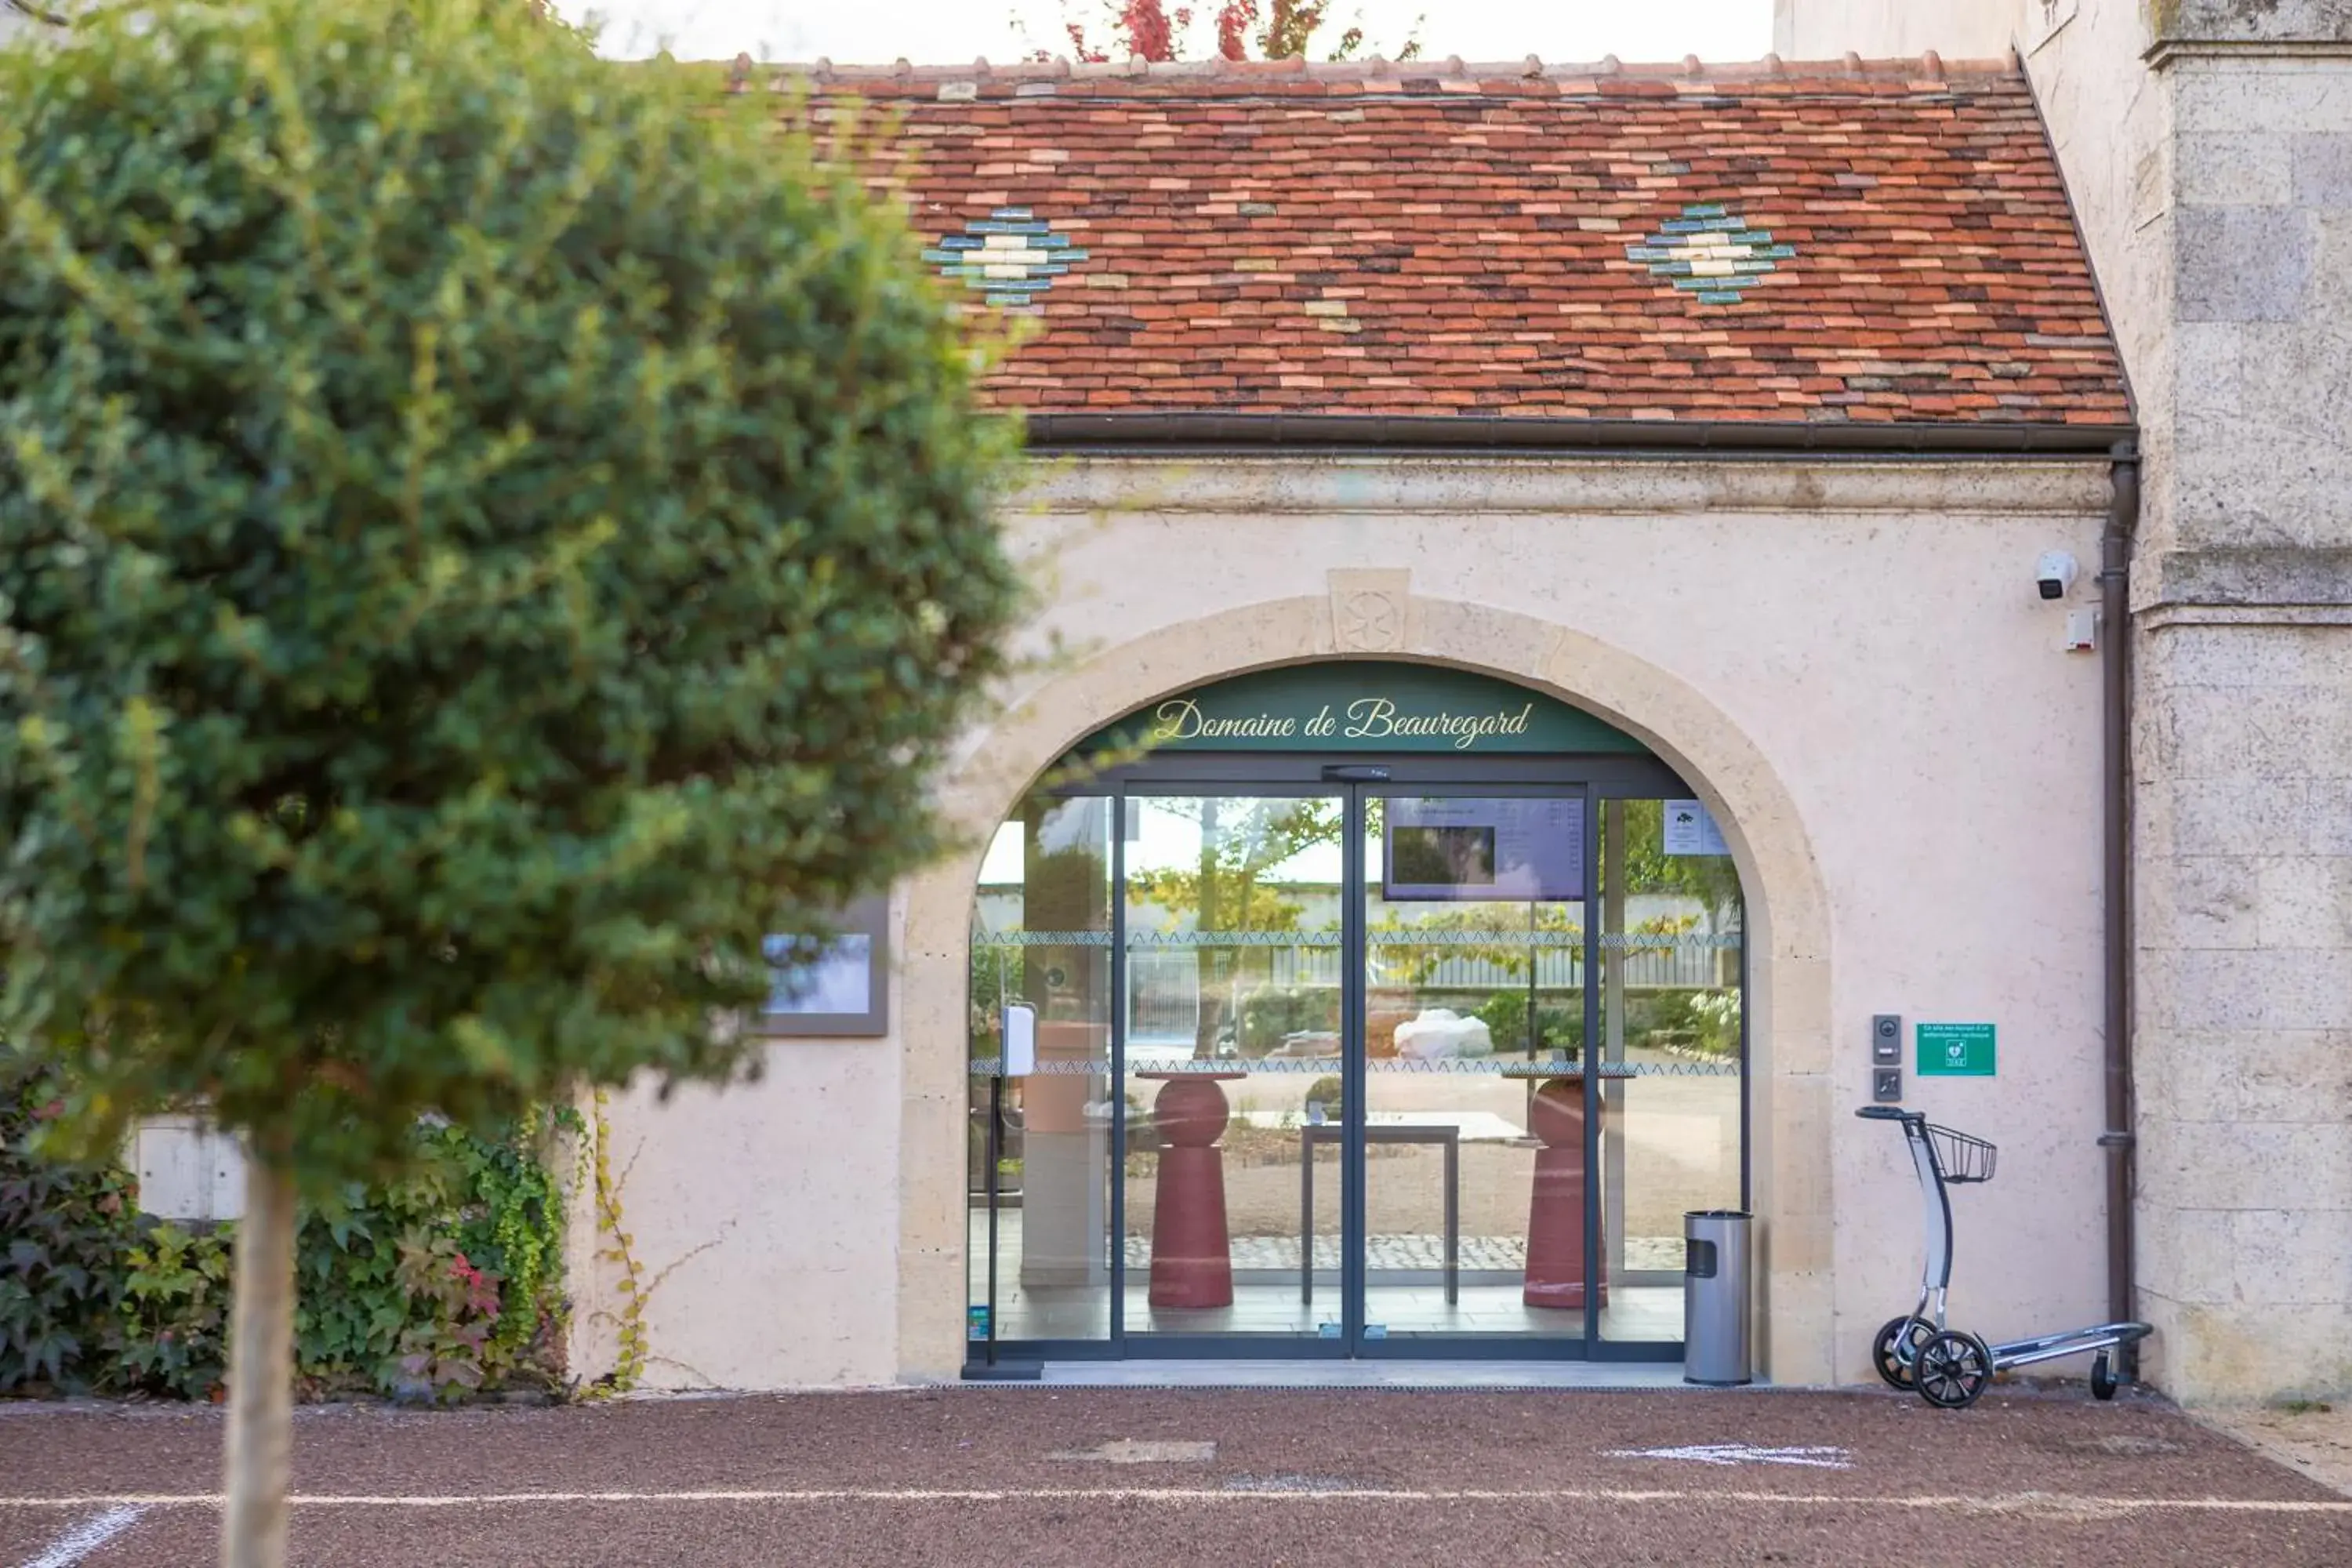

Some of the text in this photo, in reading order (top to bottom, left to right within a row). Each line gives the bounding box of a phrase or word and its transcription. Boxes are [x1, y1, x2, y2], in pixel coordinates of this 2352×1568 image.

[1154, 698, 1533, 750] Domaine de Beauregard
